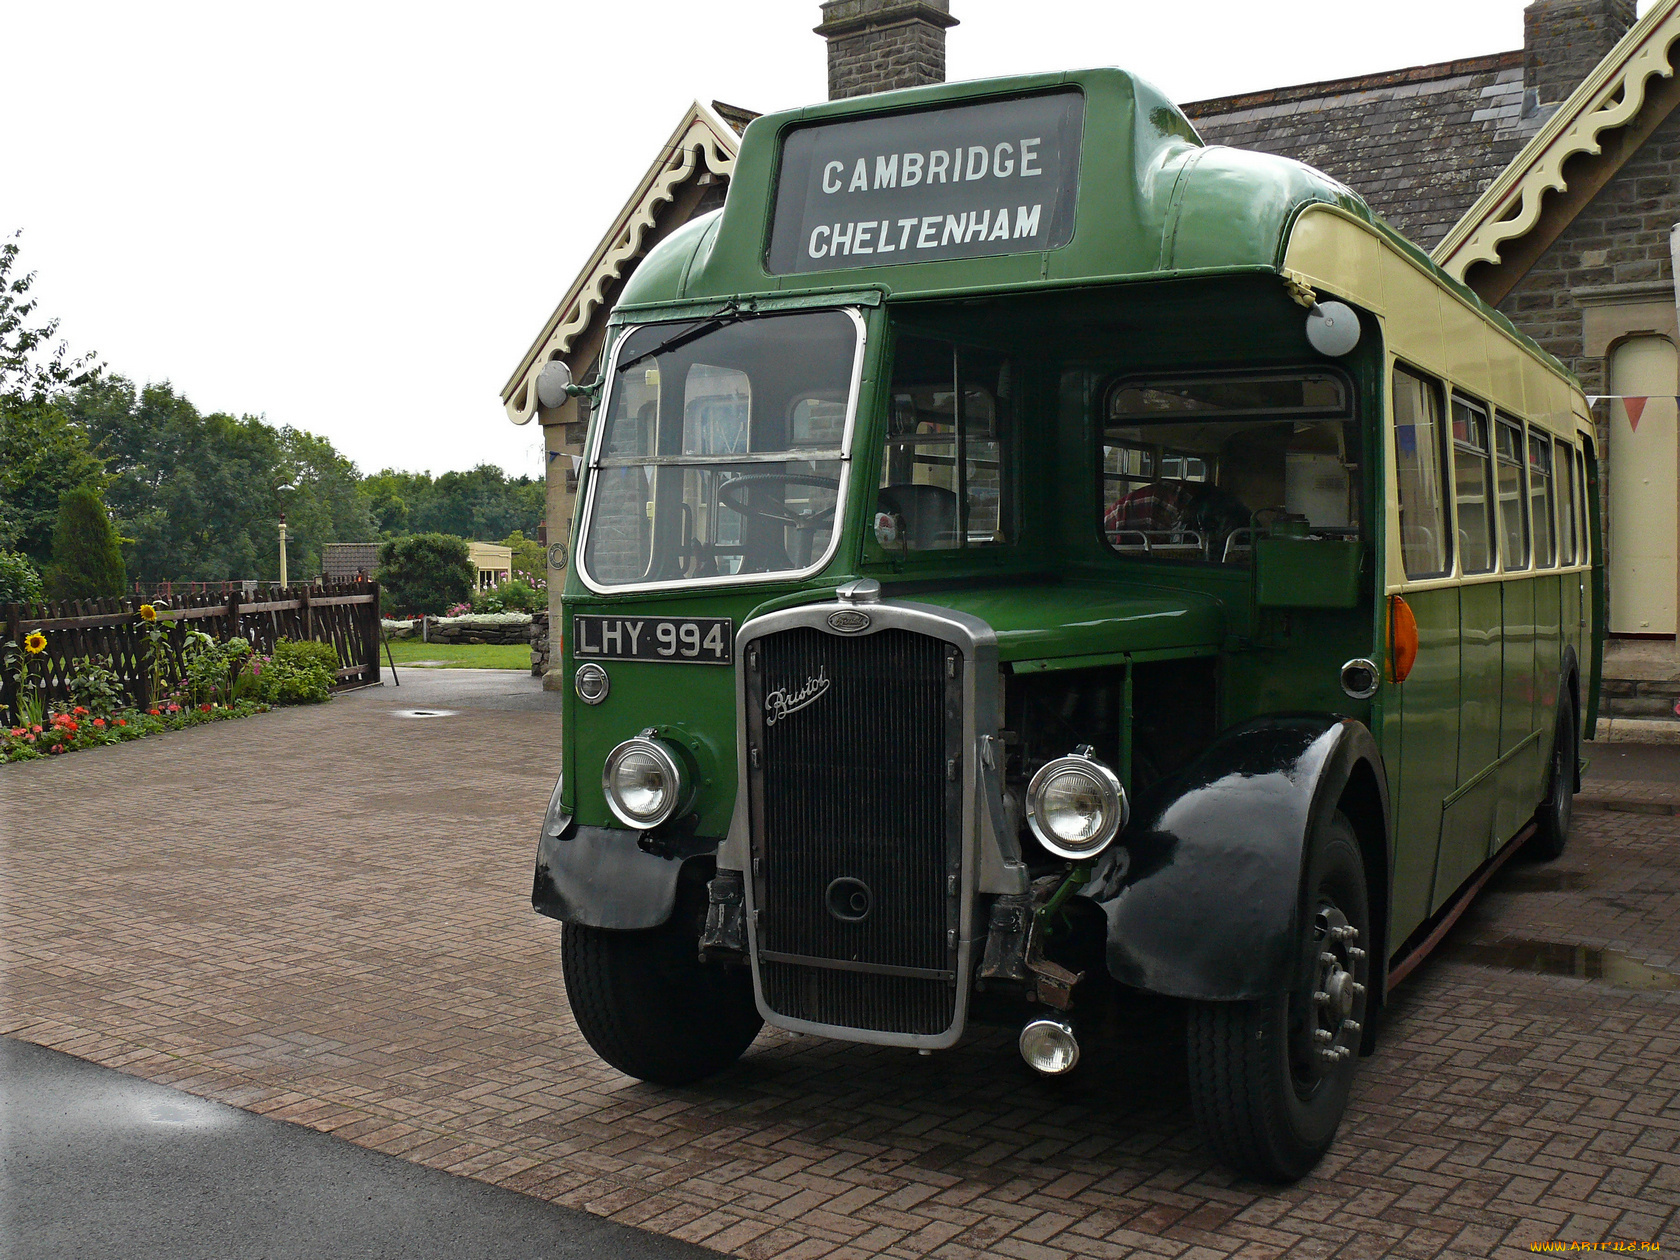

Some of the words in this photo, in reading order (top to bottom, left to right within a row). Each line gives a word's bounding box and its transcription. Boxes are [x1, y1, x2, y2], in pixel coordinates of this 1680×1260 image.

[822, 137, 1042, 194] CAMBRIDGE
[808, 204, 1042, 259] CHELTENHAM
[765, 664, 830, 727] Bristol
